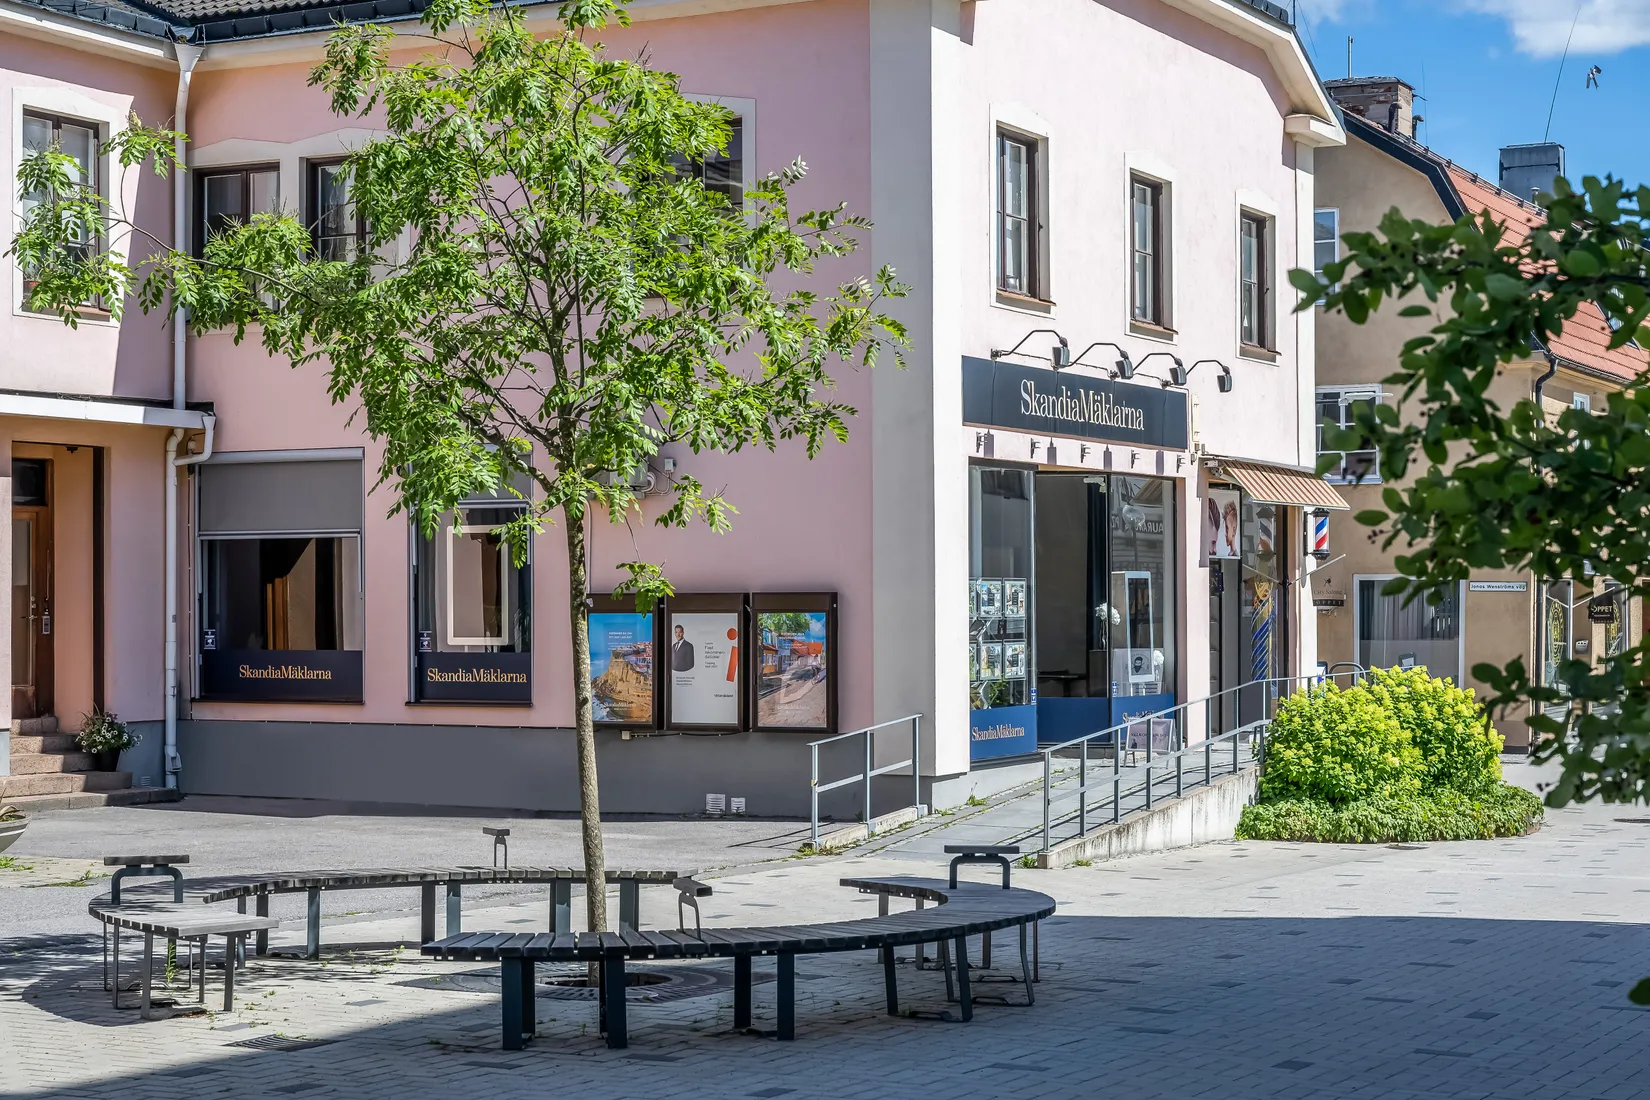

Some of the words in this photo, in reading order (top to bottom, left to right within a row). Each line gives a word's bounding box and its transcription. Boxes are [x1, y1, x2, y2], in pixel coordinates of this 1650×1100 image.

[1020, 379, 1145, 430] SkandiaMäklarna
[239, 664, 332, 680] SkandiaMäklarna
[427, 667, 528, 683] SkandiaMäklarna
[972, 723, 1025, 741] SkandiaMäklarna
